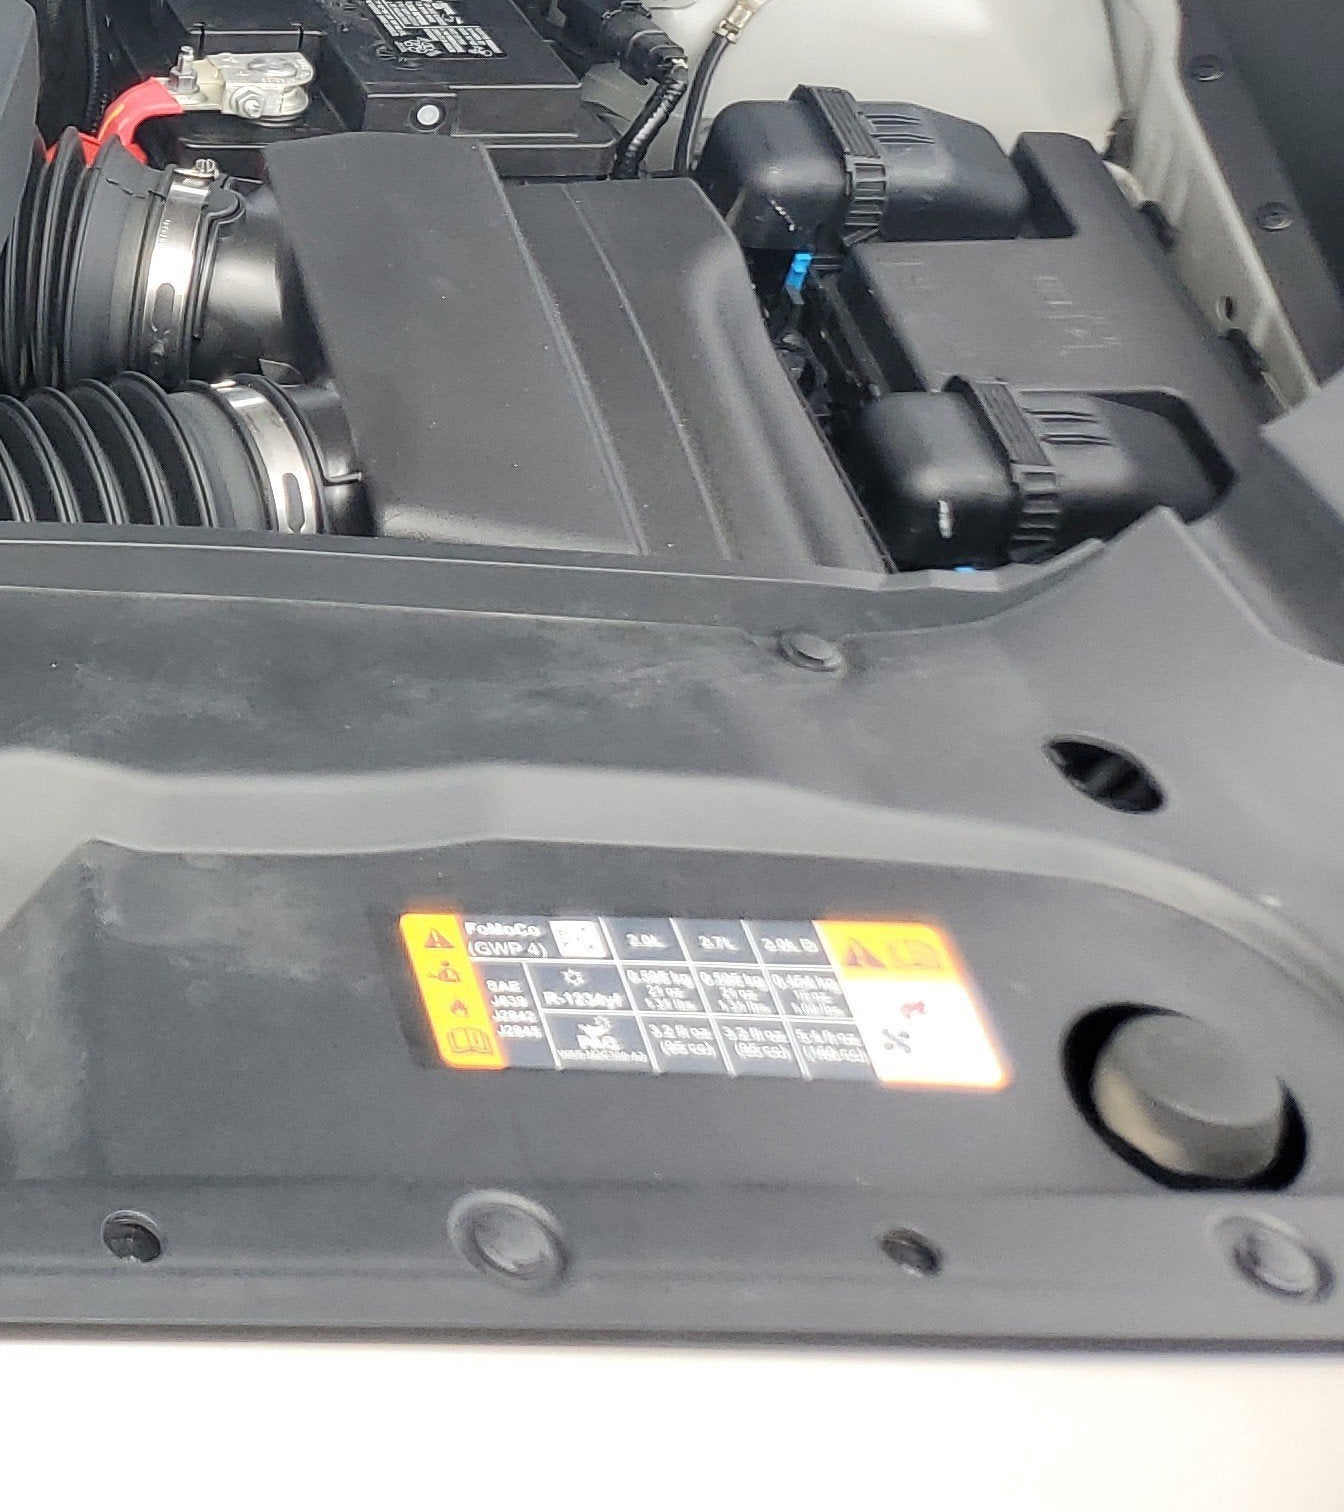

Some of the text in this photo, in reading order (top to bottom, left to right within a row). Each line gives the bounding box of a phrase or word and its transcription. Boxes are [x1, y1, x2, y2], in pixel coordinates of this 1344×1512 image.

[464, 921, 541, 937] FoMoCo
[467, 940, 548, 958] (GWP 4)
